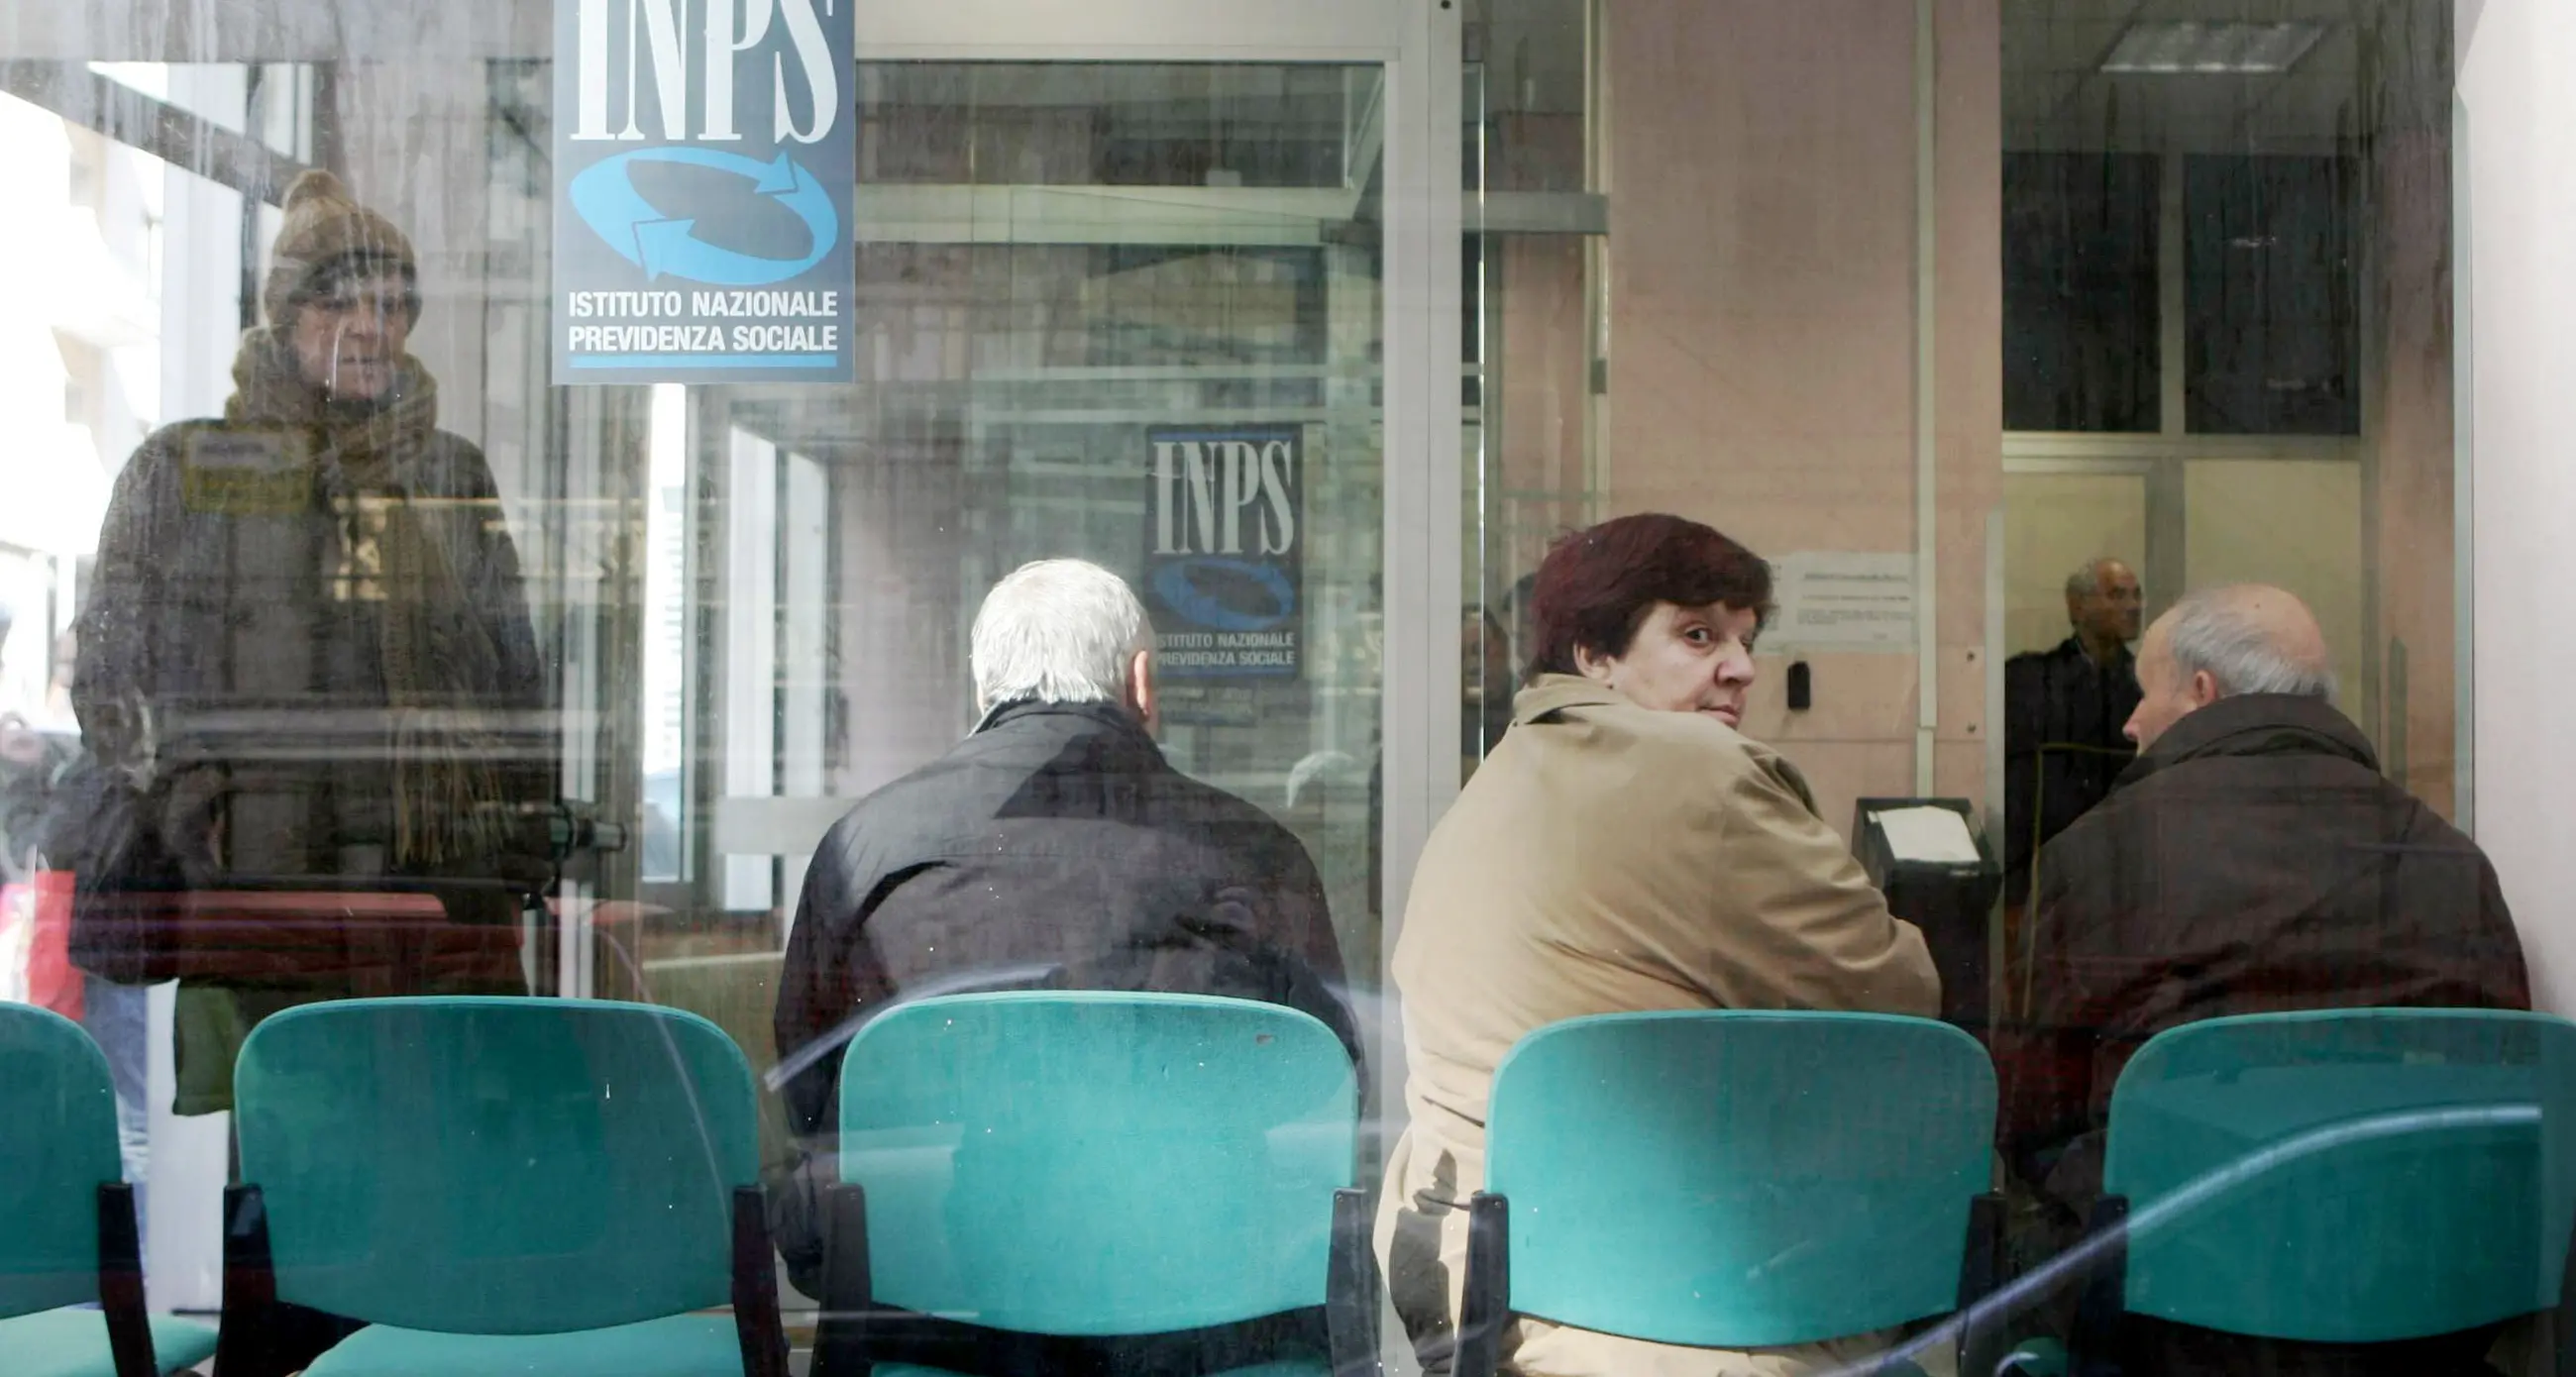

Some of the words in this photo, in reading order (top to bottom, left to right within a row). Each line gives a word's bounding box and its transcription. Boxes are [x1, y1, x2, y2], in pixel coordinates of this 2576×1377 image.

[569, 0, 837, 144] INPS
[569, 291, 682, 317] ISTITUTO
[693, 291, 837, 317] NAZIONALE
[569, 326, 725, 352] PREVIDENZA
[733, 325, 837, 352] SOCIALE
[1152, 440, 1294, 556] INPS
[1157, 633, 1213, 648] STITUTO
[1218, 632, 1295, 647] NAZIONALE
[1239, 650, 1295, 666] SOCIALE
